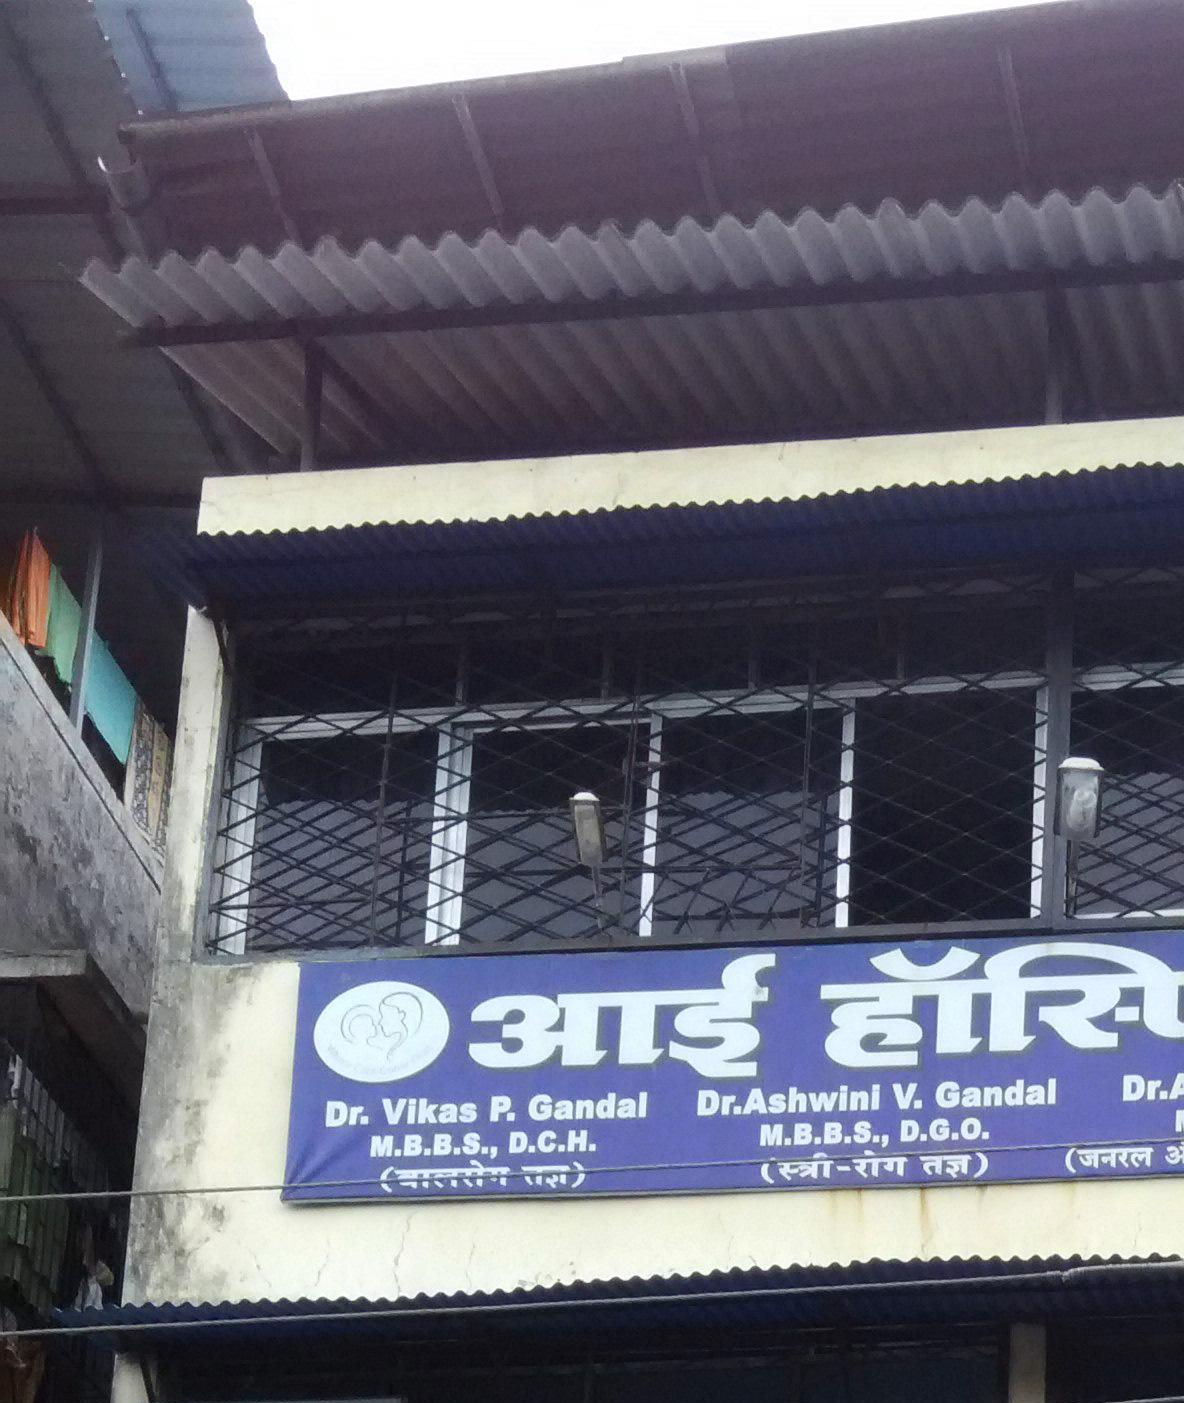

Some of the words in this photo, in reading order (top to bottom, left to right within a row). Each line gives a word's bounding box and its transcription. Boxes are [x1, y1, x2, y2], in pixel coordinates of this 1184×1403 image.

[469, 953, 776, 1078] आई
[325, 1100, 369, 1127] Dr.
[382, 1097, 477, 1125] Vikas
[490, 1095, 516, 1122] P.
[528, 1092, 648, 1120] Gandal
[697, 1083, 880, 1117] Dr.Ashwini
[893, 1082, 922, 1111] V.
[935, 1078, 1057, 1109] Gandal
[370, 1132, 498, 1159] M.B.B.S.,
[509, 1130, 597, 1154] D.C.H.
[759, 1120, 889, 1148] M.B.B.S.,
[900, 1118, 990, 1142] D.G.O.
[1065, 1146, 1152, 1173] (जनरल
